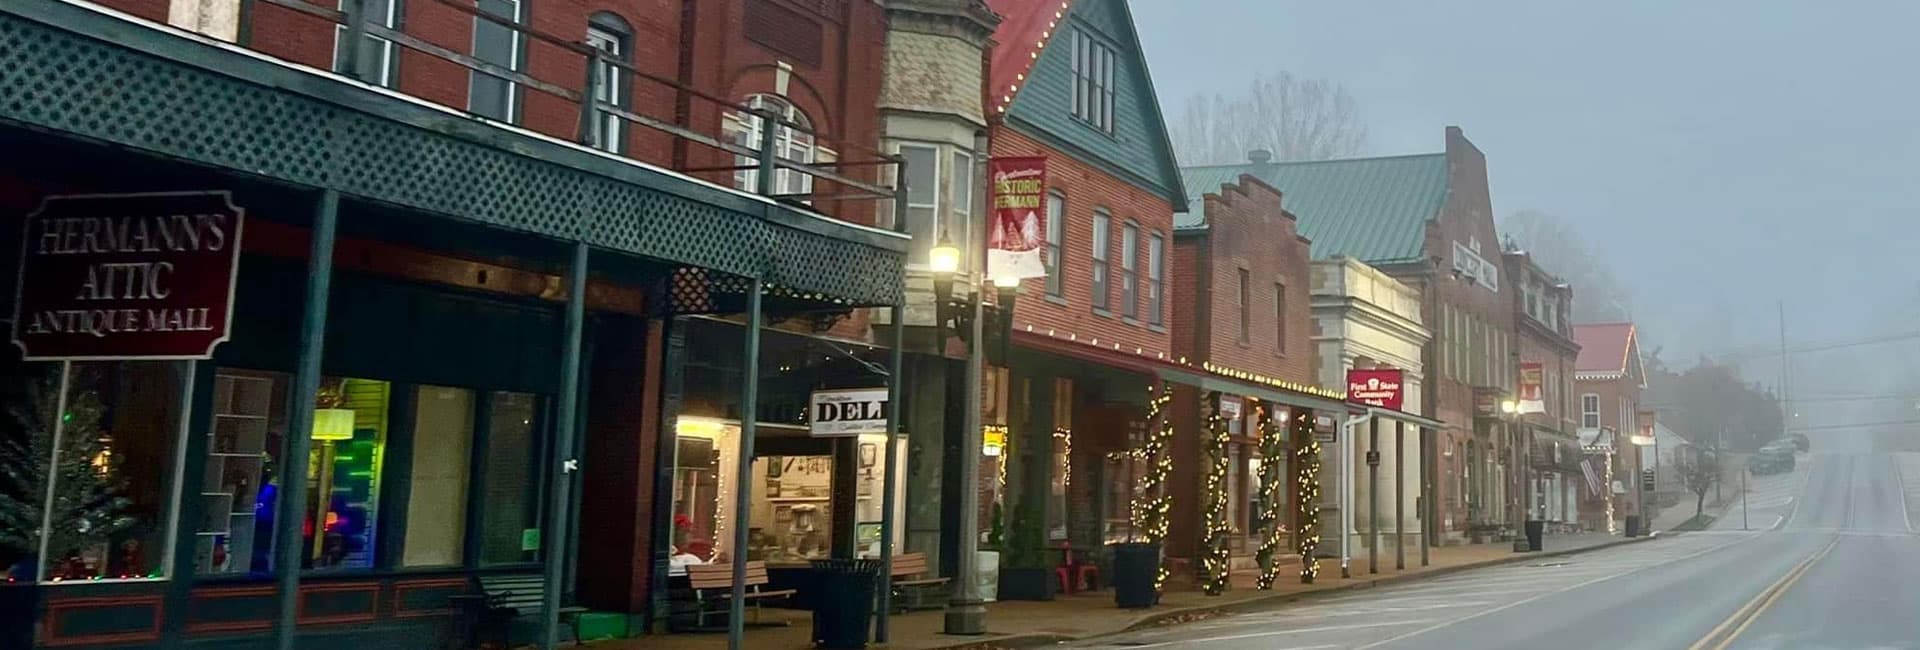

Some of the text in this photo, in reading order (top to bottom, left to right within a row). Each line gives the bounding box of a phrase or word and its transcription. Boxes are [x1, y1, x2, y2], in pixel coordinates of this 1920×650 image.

[994, 195, 1040, 209] HERMANN
[38, 214, 226, 254] HERMANN'S
[76, 262, 174, 300] ATTIC
[26, 308, 214, 337] ANTIQUE MALL
[1351, 381, 1399, 391] First State
[1354, 391, 1395, 400] Community
